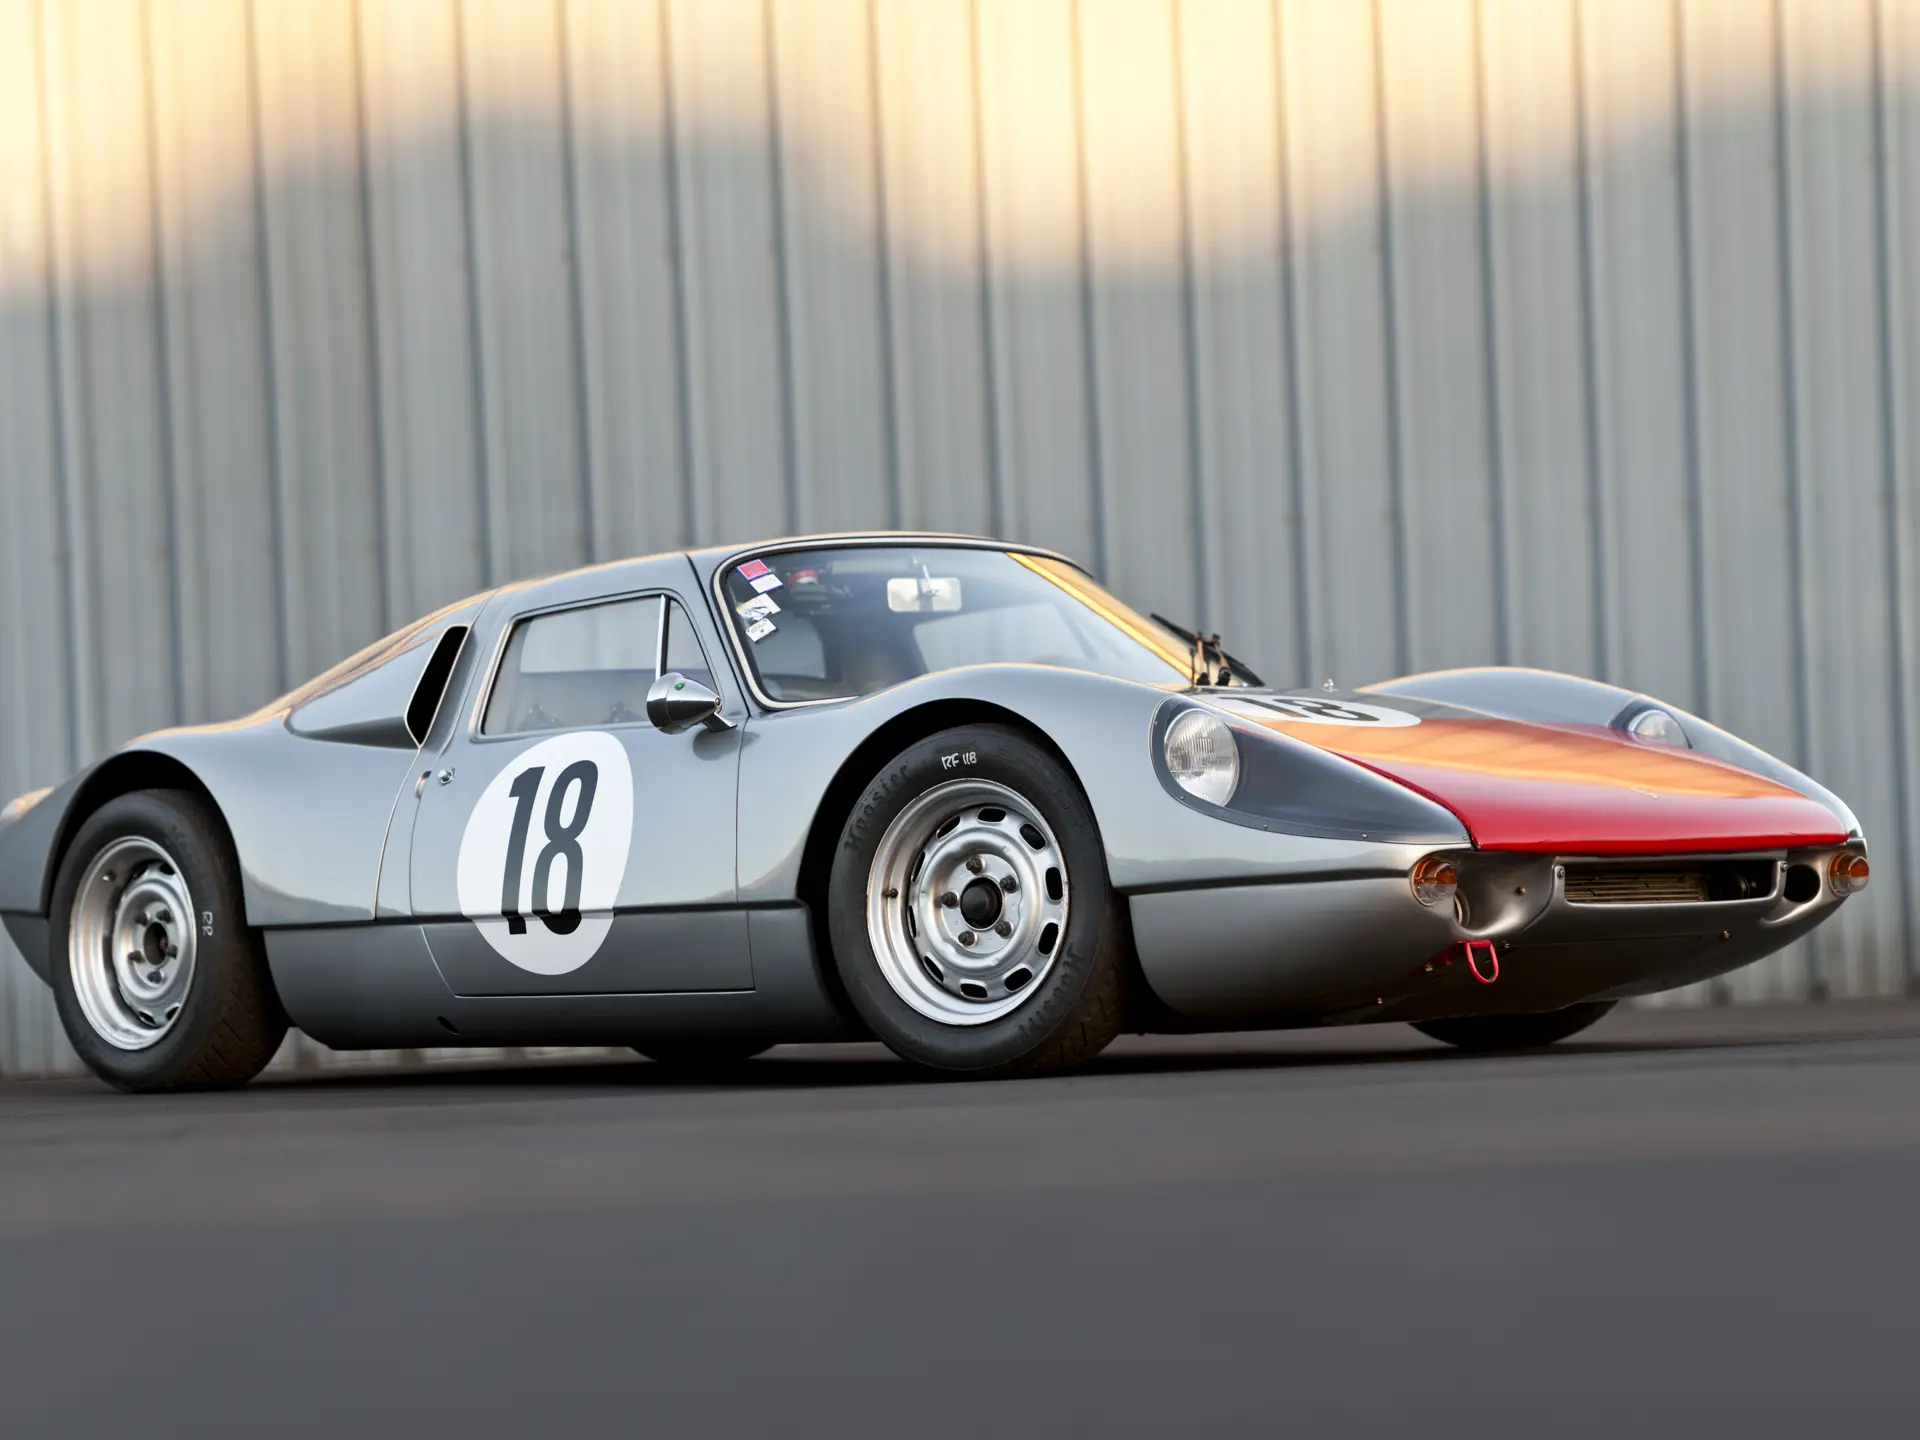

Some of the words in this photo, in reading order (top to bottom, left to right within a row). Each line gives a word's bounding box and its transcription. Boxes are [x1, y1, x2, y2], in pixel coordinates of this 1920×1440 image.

[1217, 697, 1381, 721] 18
[941, 752, 960, 770] RF
[962, 751, 977, 765] 118
[501, 760, 599, 936] 18
